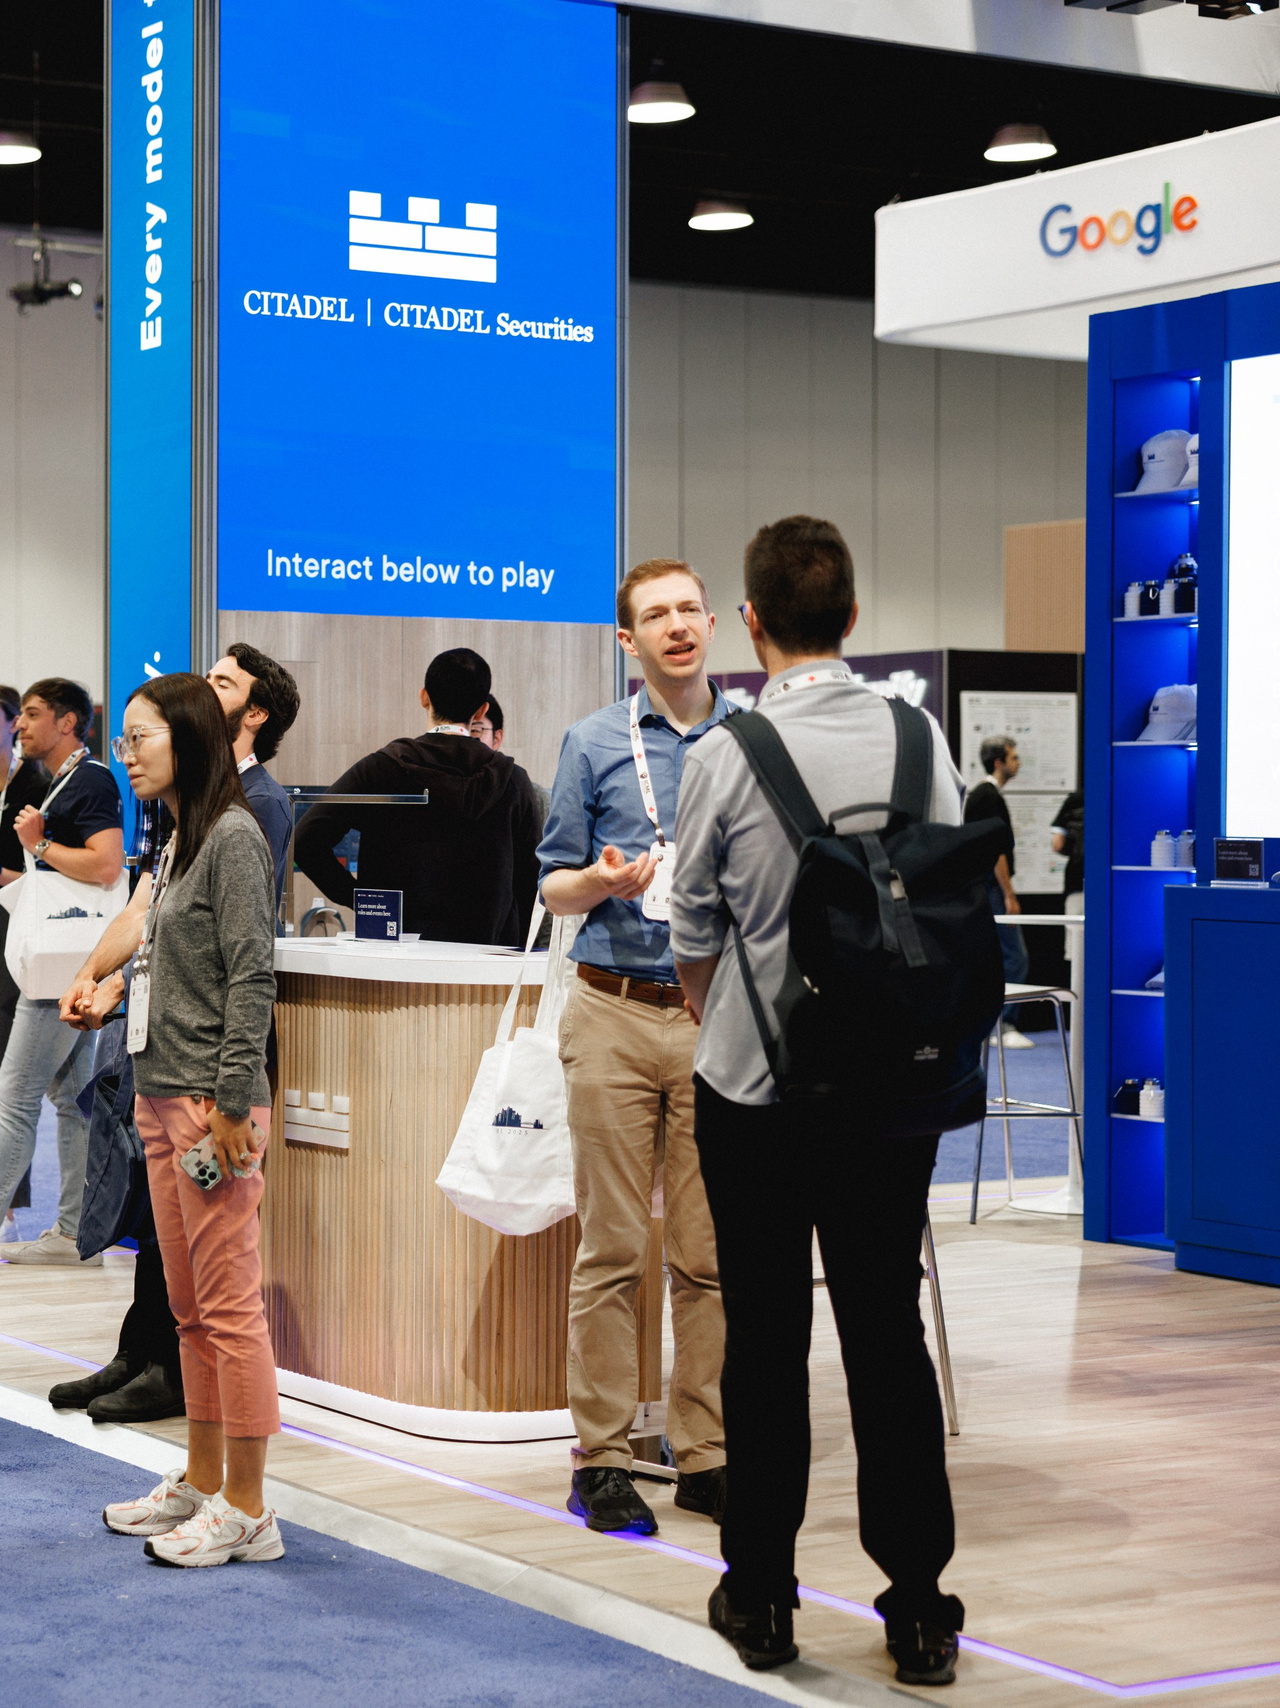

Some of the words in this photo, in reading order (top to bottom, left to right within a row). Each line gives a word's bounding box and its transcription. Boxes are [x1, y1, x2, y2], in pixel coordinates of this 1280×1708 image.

[142, 21, 163, 183] model
[1040, 181, 1198, 256] Google
[141, 202, 167, 350] Every
[244, 290, 354, 322] CITADEL
[384, 303, 490, 333] CITADEL
[497, 313, 593, 342] Securities
[268, 549, 372, 580] Interact
[383, 555, 460, 584] below
[468, 561, 493, 585] to
[503, 561, 554, 594] play
